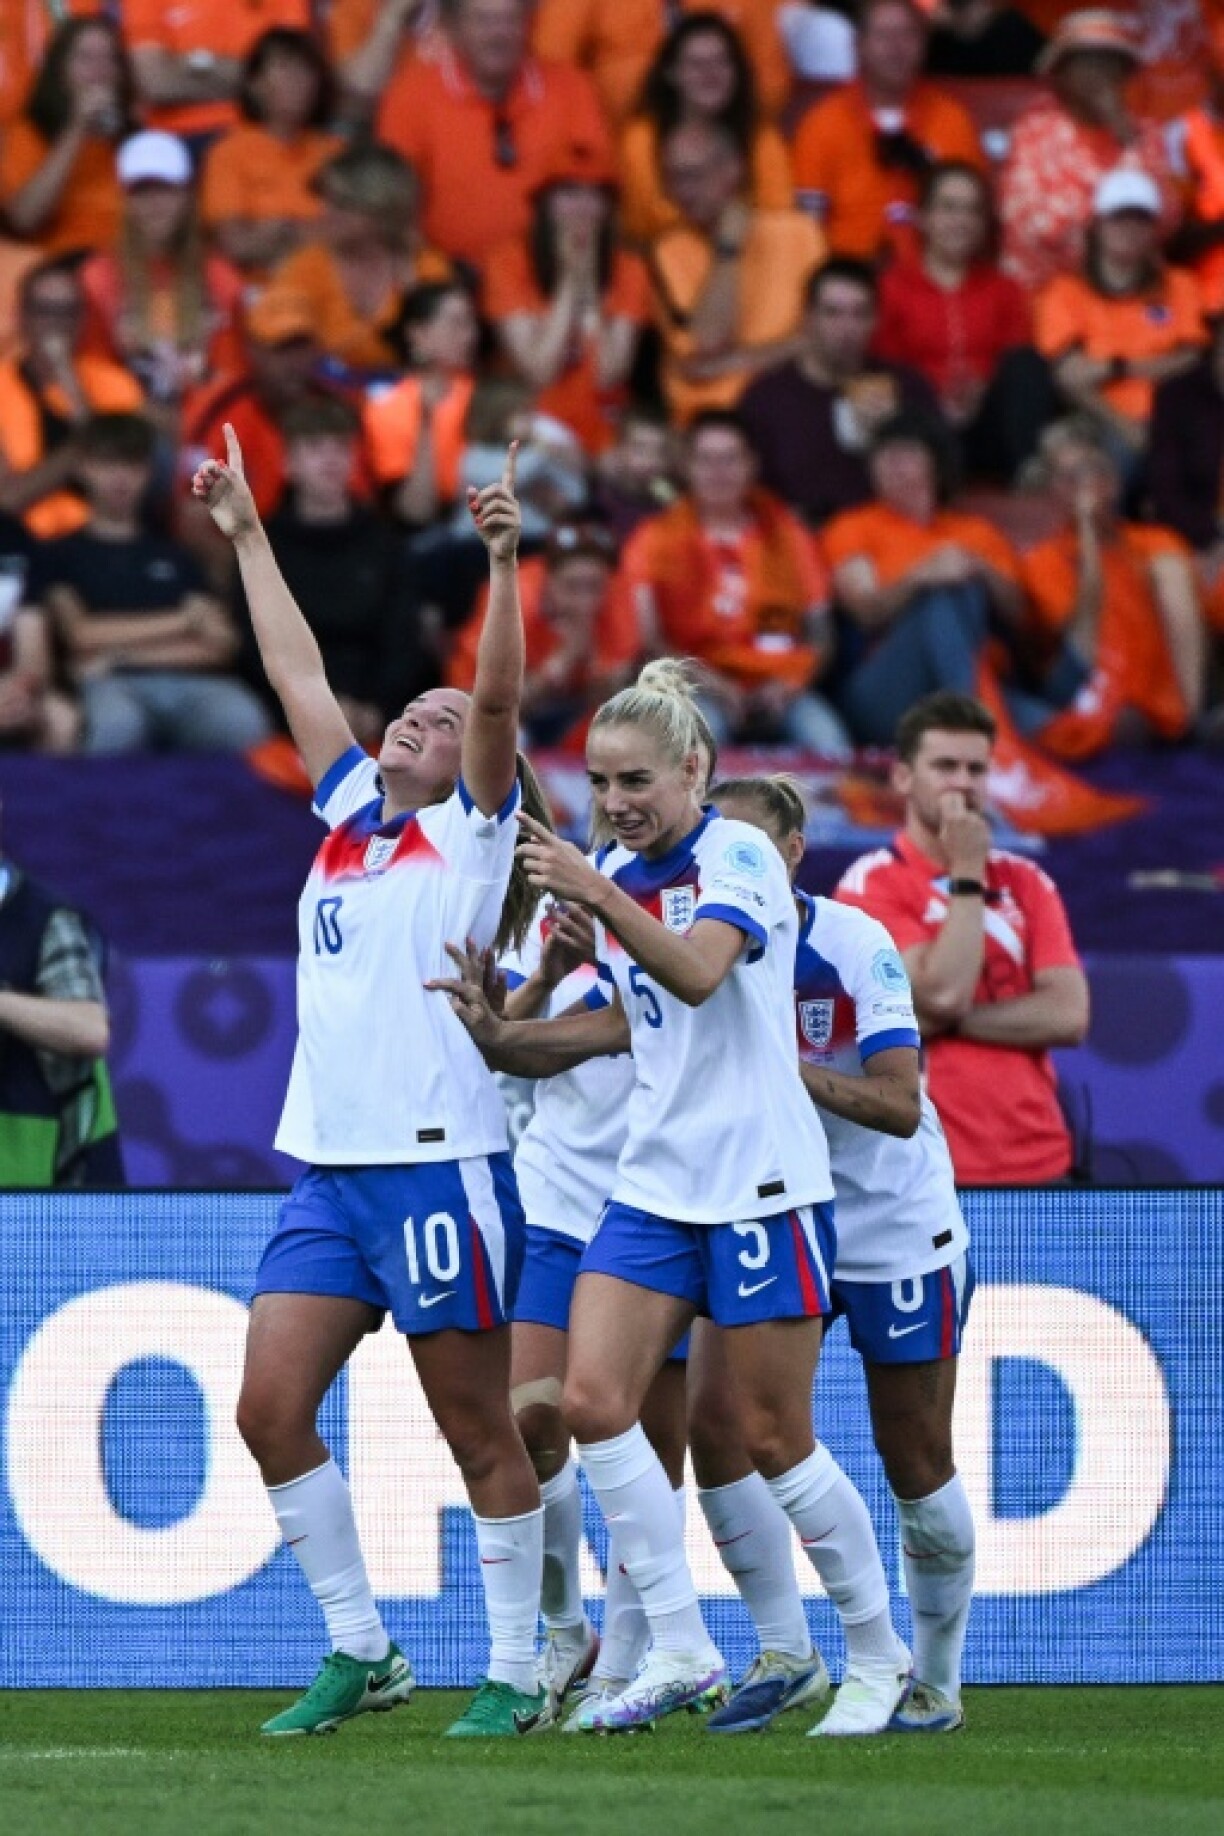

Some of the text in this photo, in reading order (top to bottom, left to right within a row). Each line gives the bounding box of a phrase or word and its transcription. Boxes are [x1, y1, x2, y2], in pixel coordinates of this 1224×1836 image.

[314, 895, 343, 955] 10
[628, 964, 663, 1029] 5
[403, 1211, 460, 1284] 10
